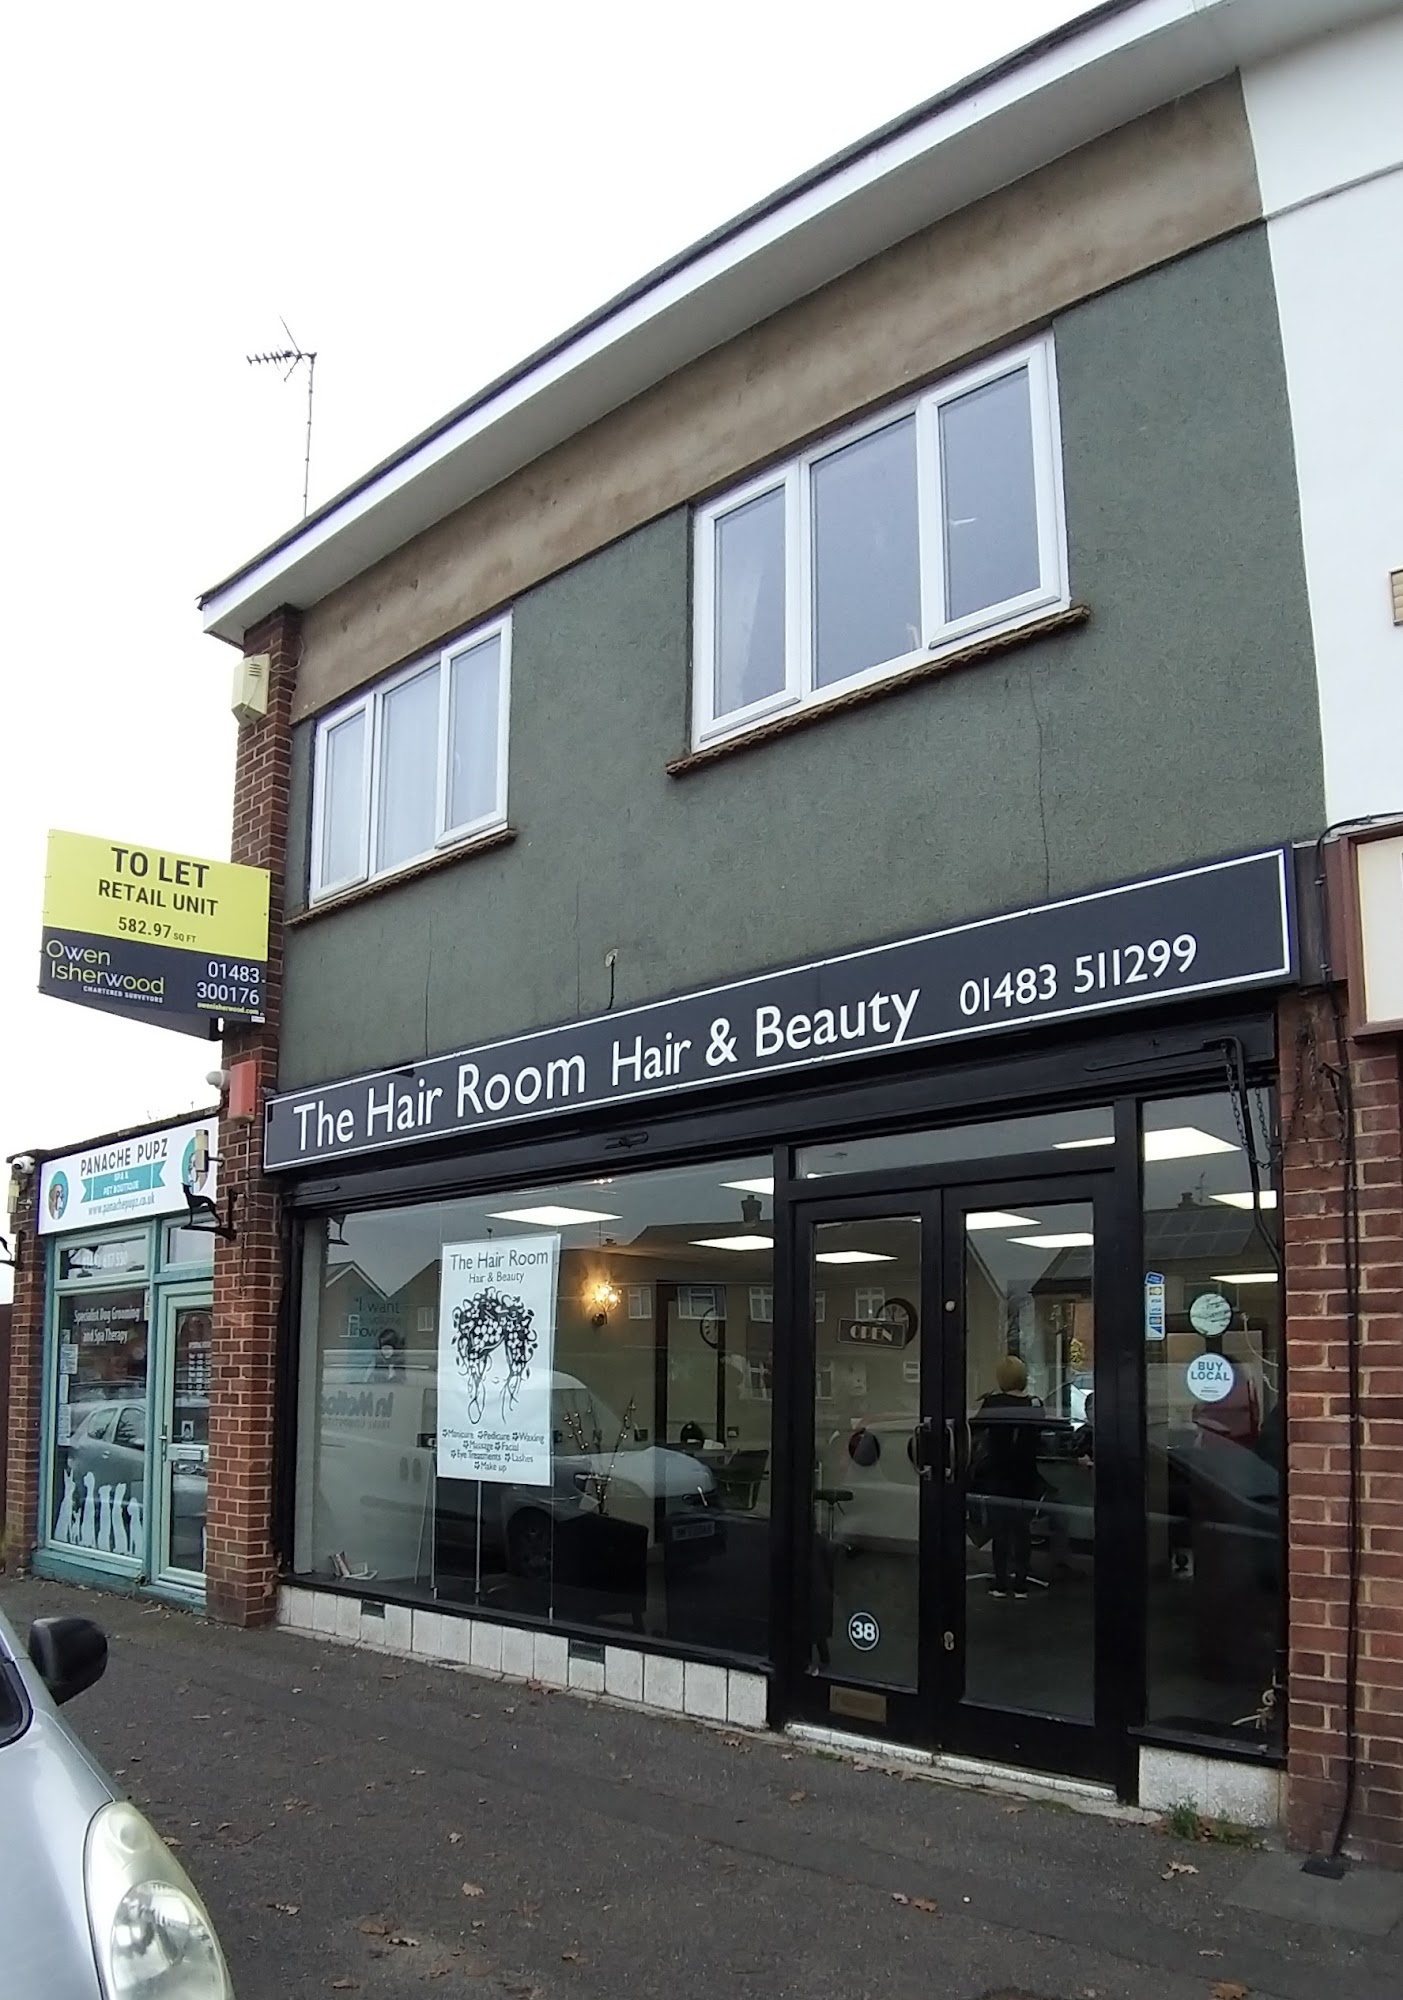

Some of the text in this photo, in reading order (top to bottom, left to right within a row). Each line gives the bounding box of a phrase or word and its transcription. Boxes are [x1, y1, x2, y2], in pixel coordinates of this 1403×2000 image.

[110, 846, 210, 888] TO LET
[98, 879, 219, 916] RETAIL UNIT
[118, 916, 197, 943] 582.97 SQ FT
[46, 939, 111, 966] Owen
[51, 960, 165, 995] Isherwood
[207, 960, 260, 984] 01483
[82, 985, 164, 1003] CHARTERED SURVEYORS
[196, 981, 260, 1005] 300176
[196, 1002, 260, 1015] owenisherwood.com
[293, 933, 1198, 1151] The Hair Room Hair & Beauty 01483 511299
[80, 1137, 168, 1177] PANACHE PUPZ
[88, 1191, 155, 1216] www.panachepupz.co.uk
[449, 1249, 549, 1271] The Hair Room
[469, 1271, 525, 1284] Hair & Beauty
[73, 1305, 140, 1325] Specialist Dog Grooming
[368, 1302, 401, 1314] want
[83, 1328, 94, 1342] and
[94, 1328, 105, 1345] Spa
[105, 1327, 128, 1344] Therapy
[849, 1325, 894, 1342] OPEN
[1197, 1361, 1224, 1371] BUY
[1190, 1371, 1231, 1382] LOCAL
[448, 1429, 545, 1445] Manicure Pedicure Waxing
[469, 1440, 520, 1452] Massage Facial
[457, 1449, 534, 1463] Eye Treatments Lashes
[480, 1461, 507, 1473] Make up
[851, 1620, 876, 1642] 38
